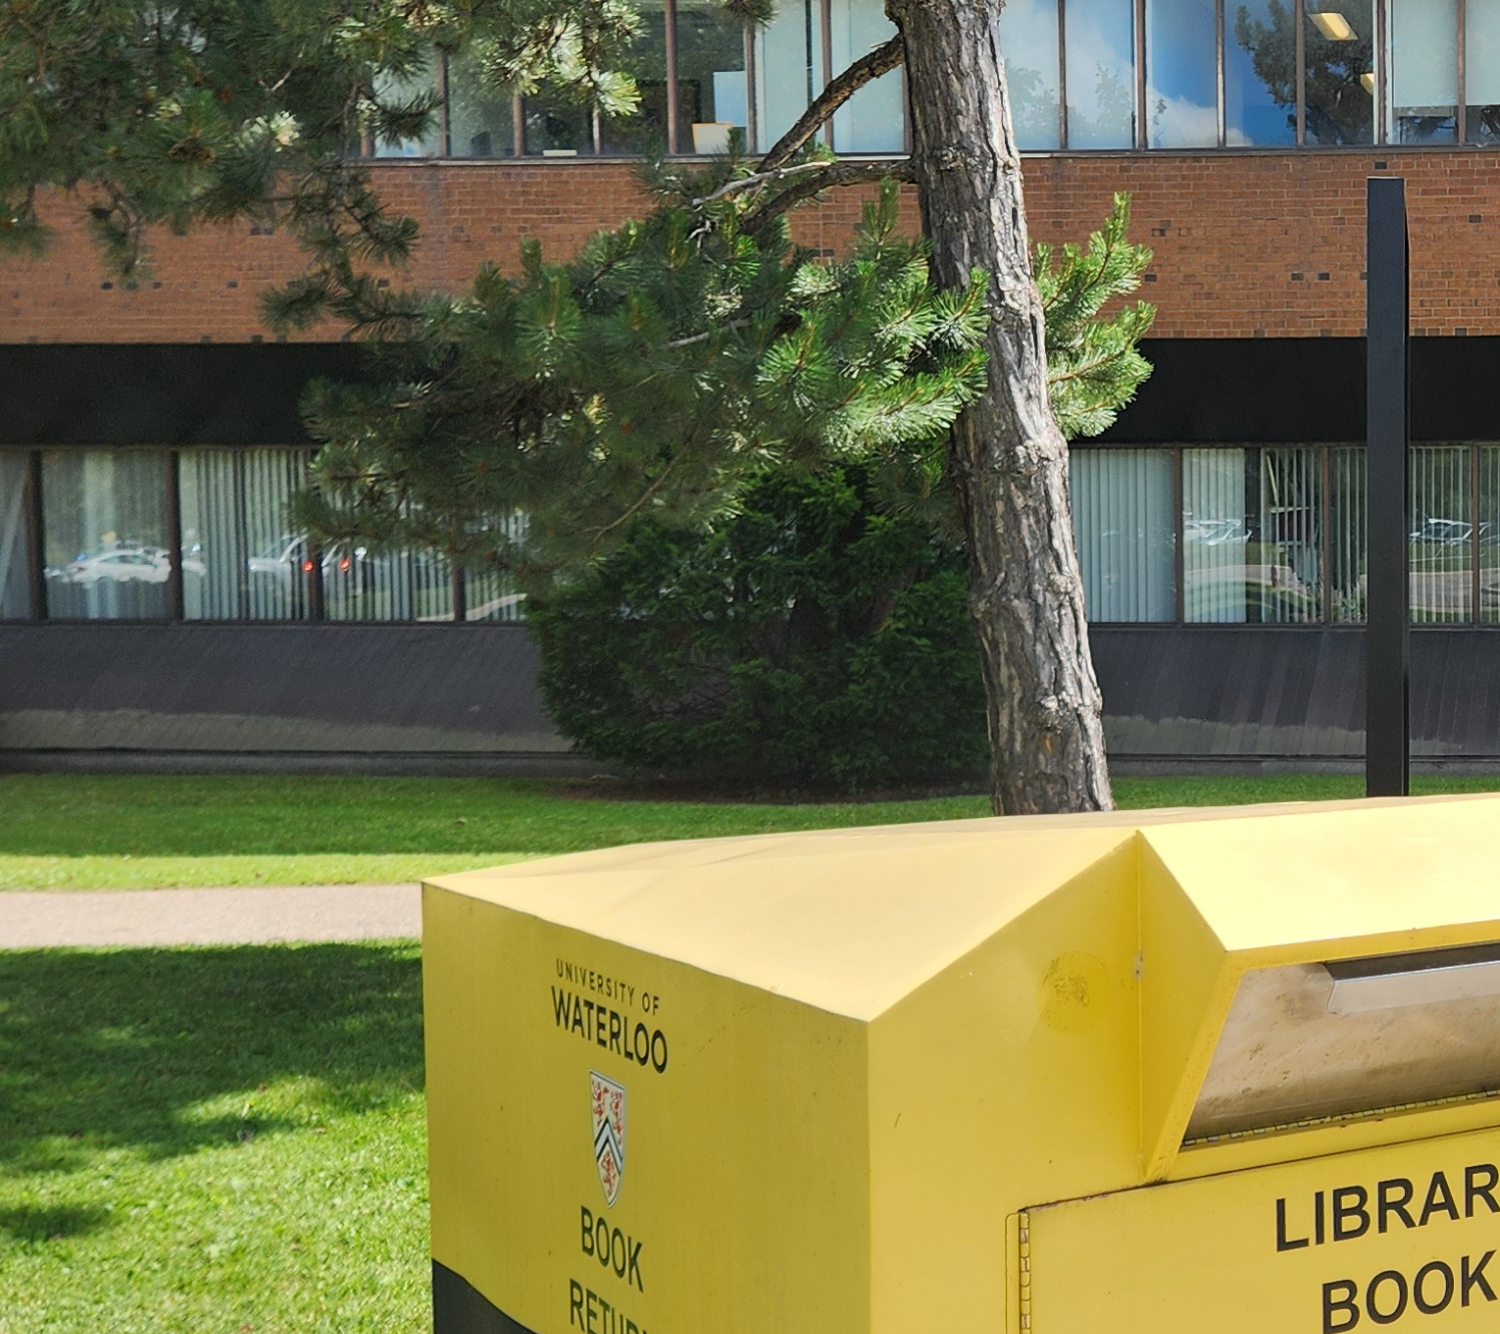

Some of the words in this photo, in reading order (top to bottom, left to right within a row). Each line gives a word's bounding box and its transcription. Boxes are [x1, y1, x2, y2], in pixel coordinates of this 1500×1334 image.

[550, 985, 668, 1074] WATERLOO
[556, 957, 635, 1007] UNIVERSITY
[641, 991, 660, 1016] OF
[580, 1204, 644, 1294] BOOK
